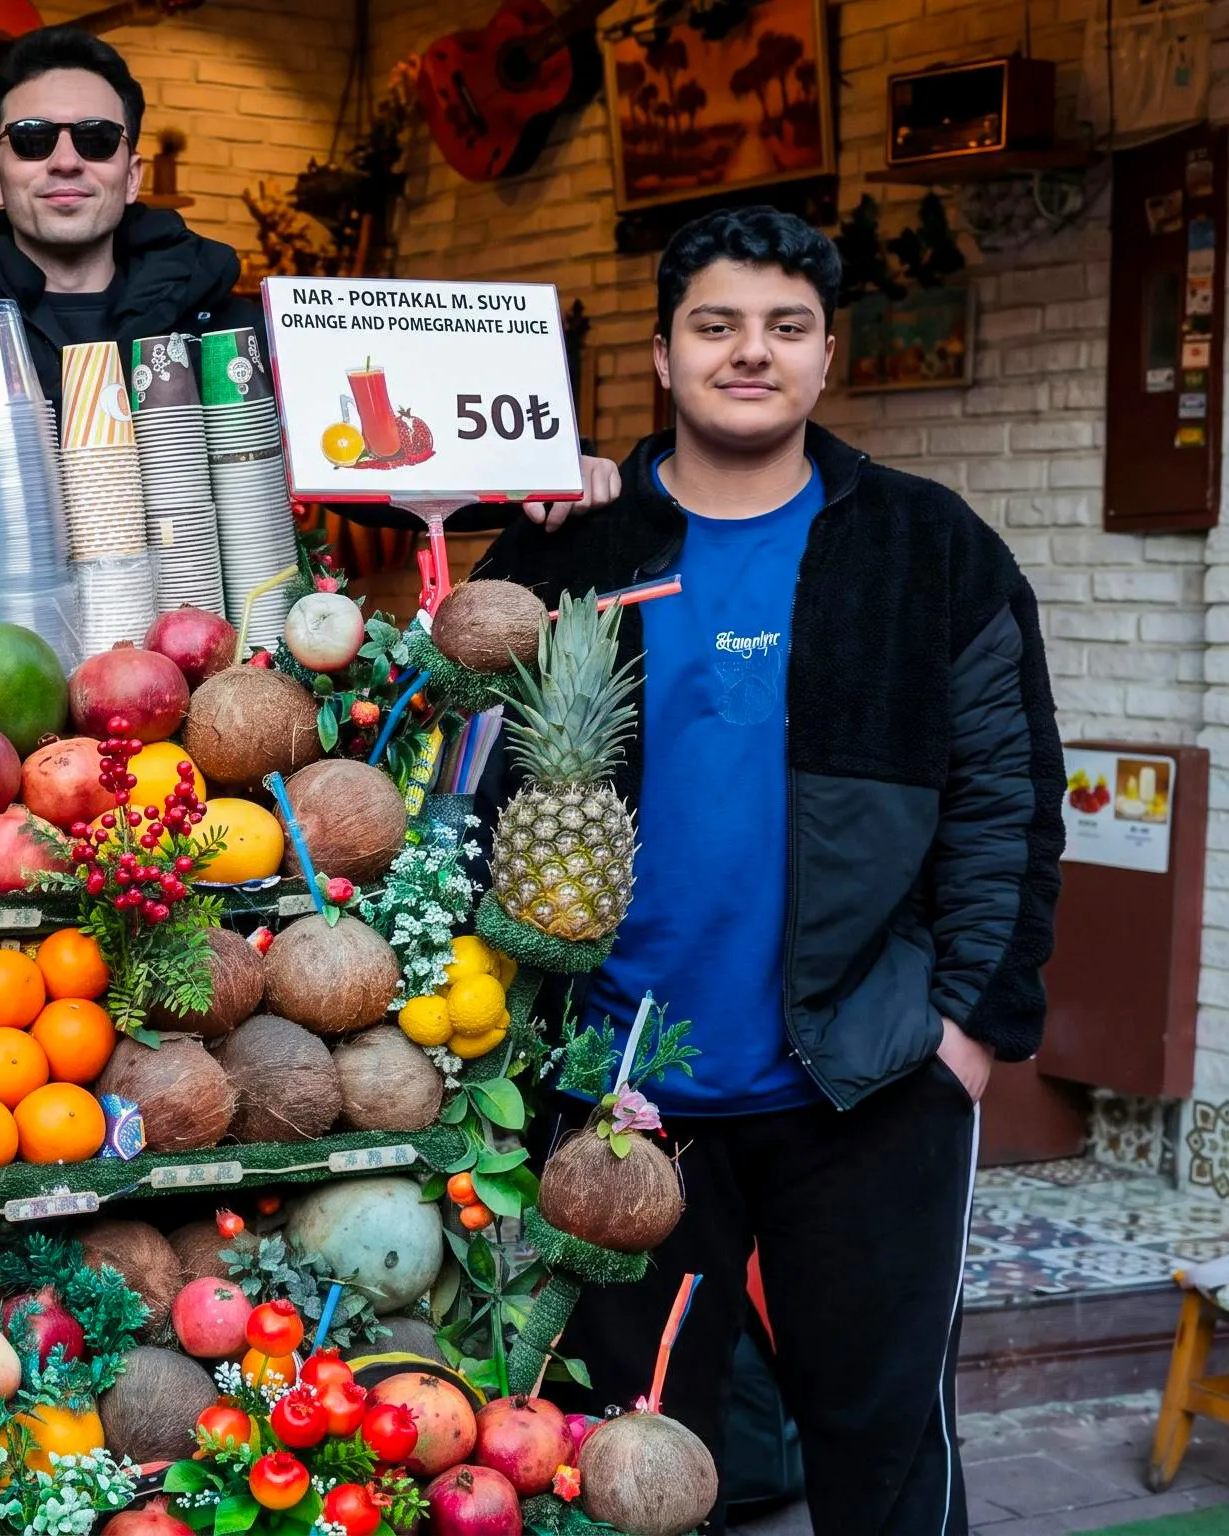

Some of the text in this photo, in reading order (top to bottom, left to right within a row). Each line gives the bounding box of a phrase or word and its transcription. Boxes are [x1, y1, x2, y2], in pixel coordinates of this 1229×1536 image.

[294, 289, 333, 304] NAR
[349, 291, 447, 308] PORTAKAL
[452, 295, 473, 309] M.
[478, 295, 525, 310] SUYU
[282, 314, 548, 334] ORANGE AND POMEGRANATE JUICE
[457, 395, 559, 440] 50₺
